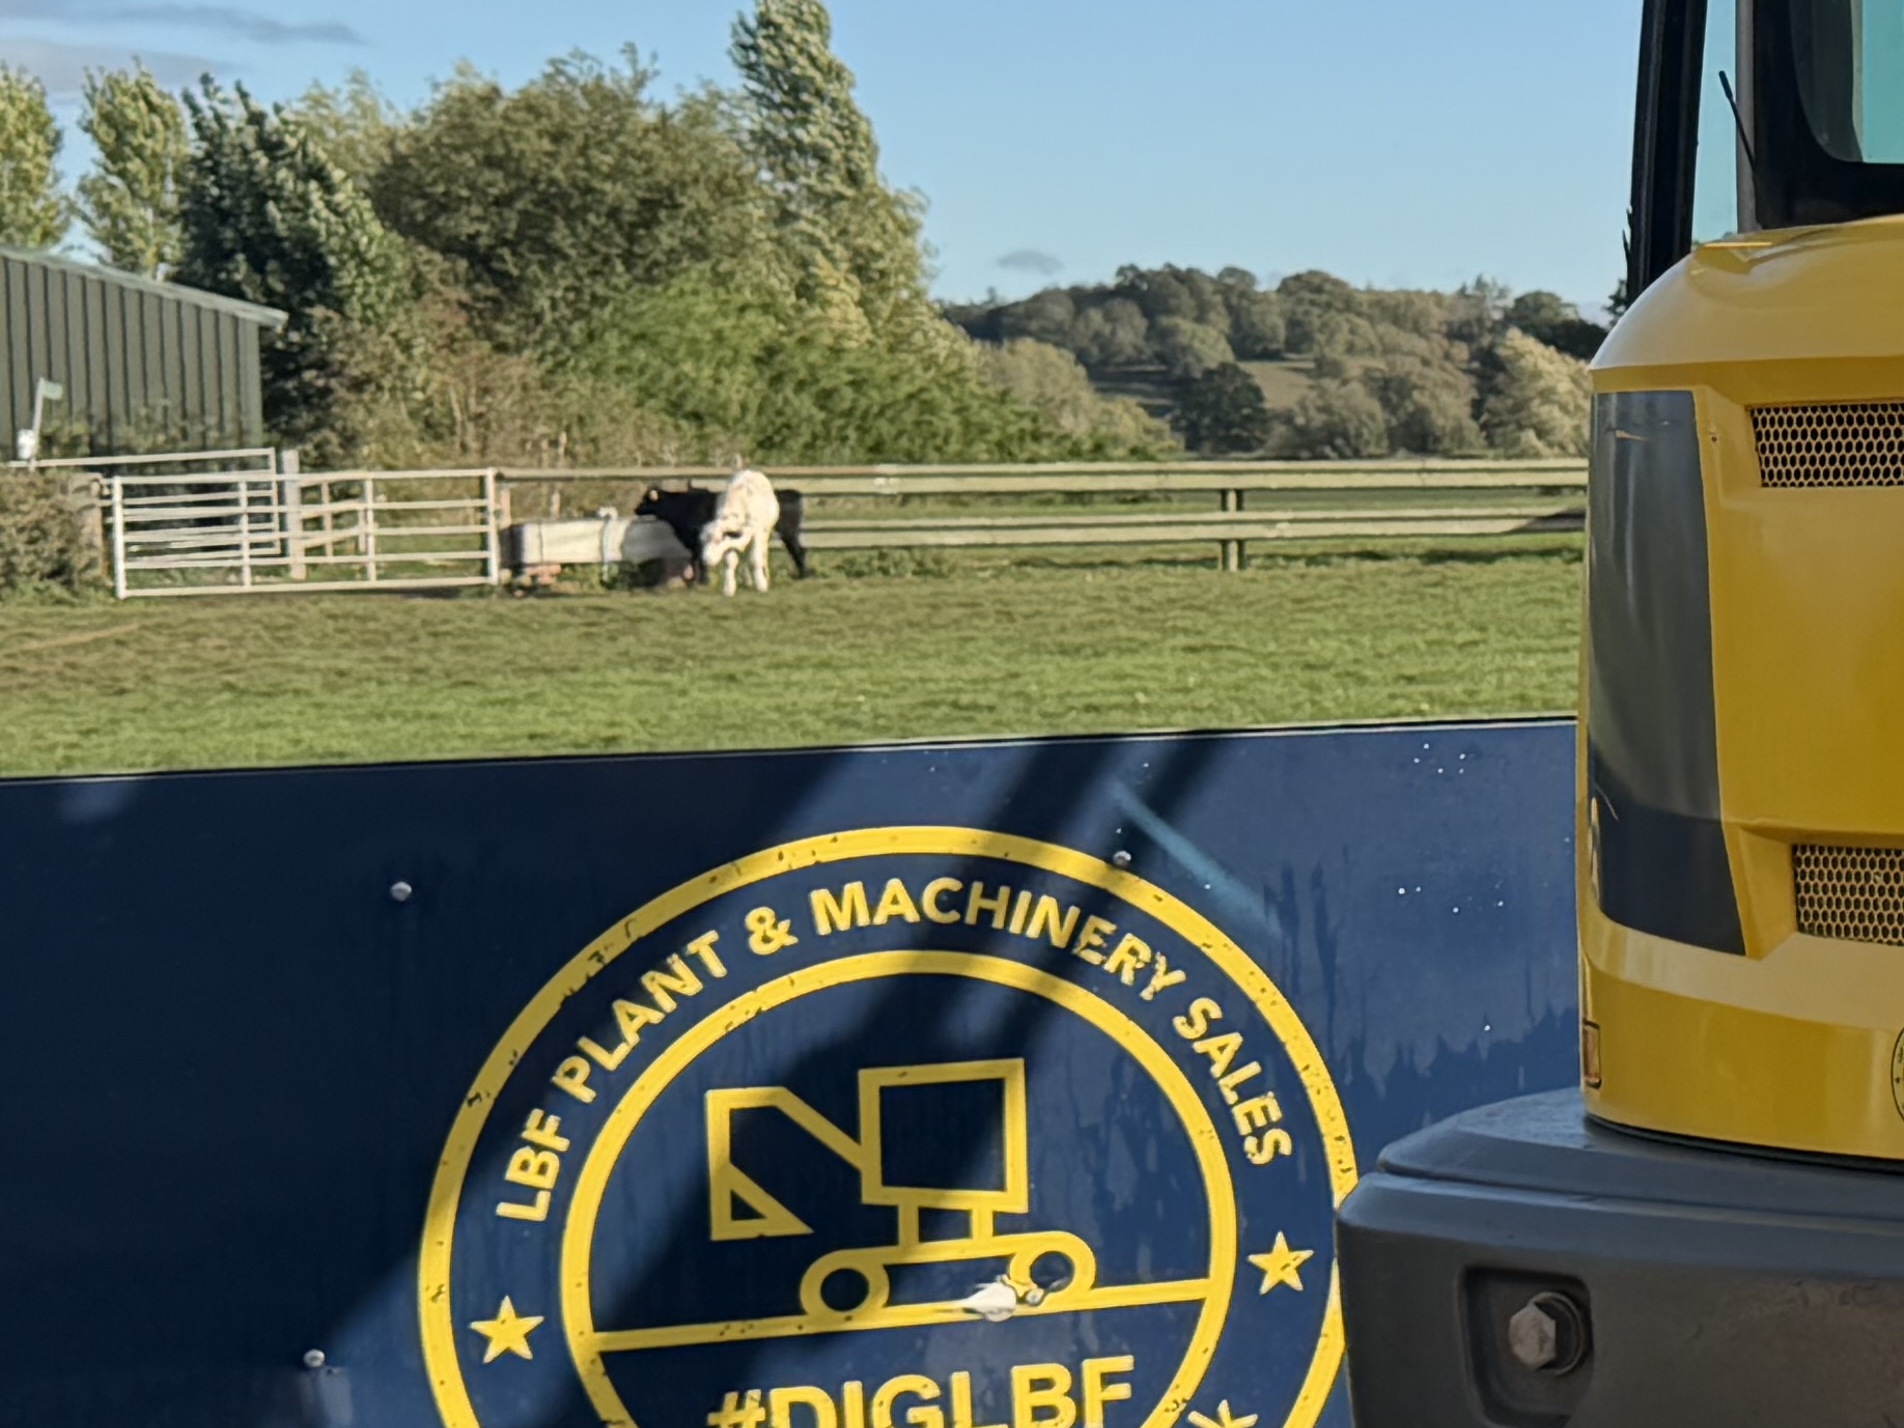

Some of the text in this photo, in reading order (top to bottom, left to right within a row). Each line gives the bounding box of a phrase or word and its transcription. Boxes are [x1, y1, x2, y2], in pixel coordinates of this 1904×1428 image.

[496, 877, 1294, 1222] LBF PLANT & MACHINERY SALES
